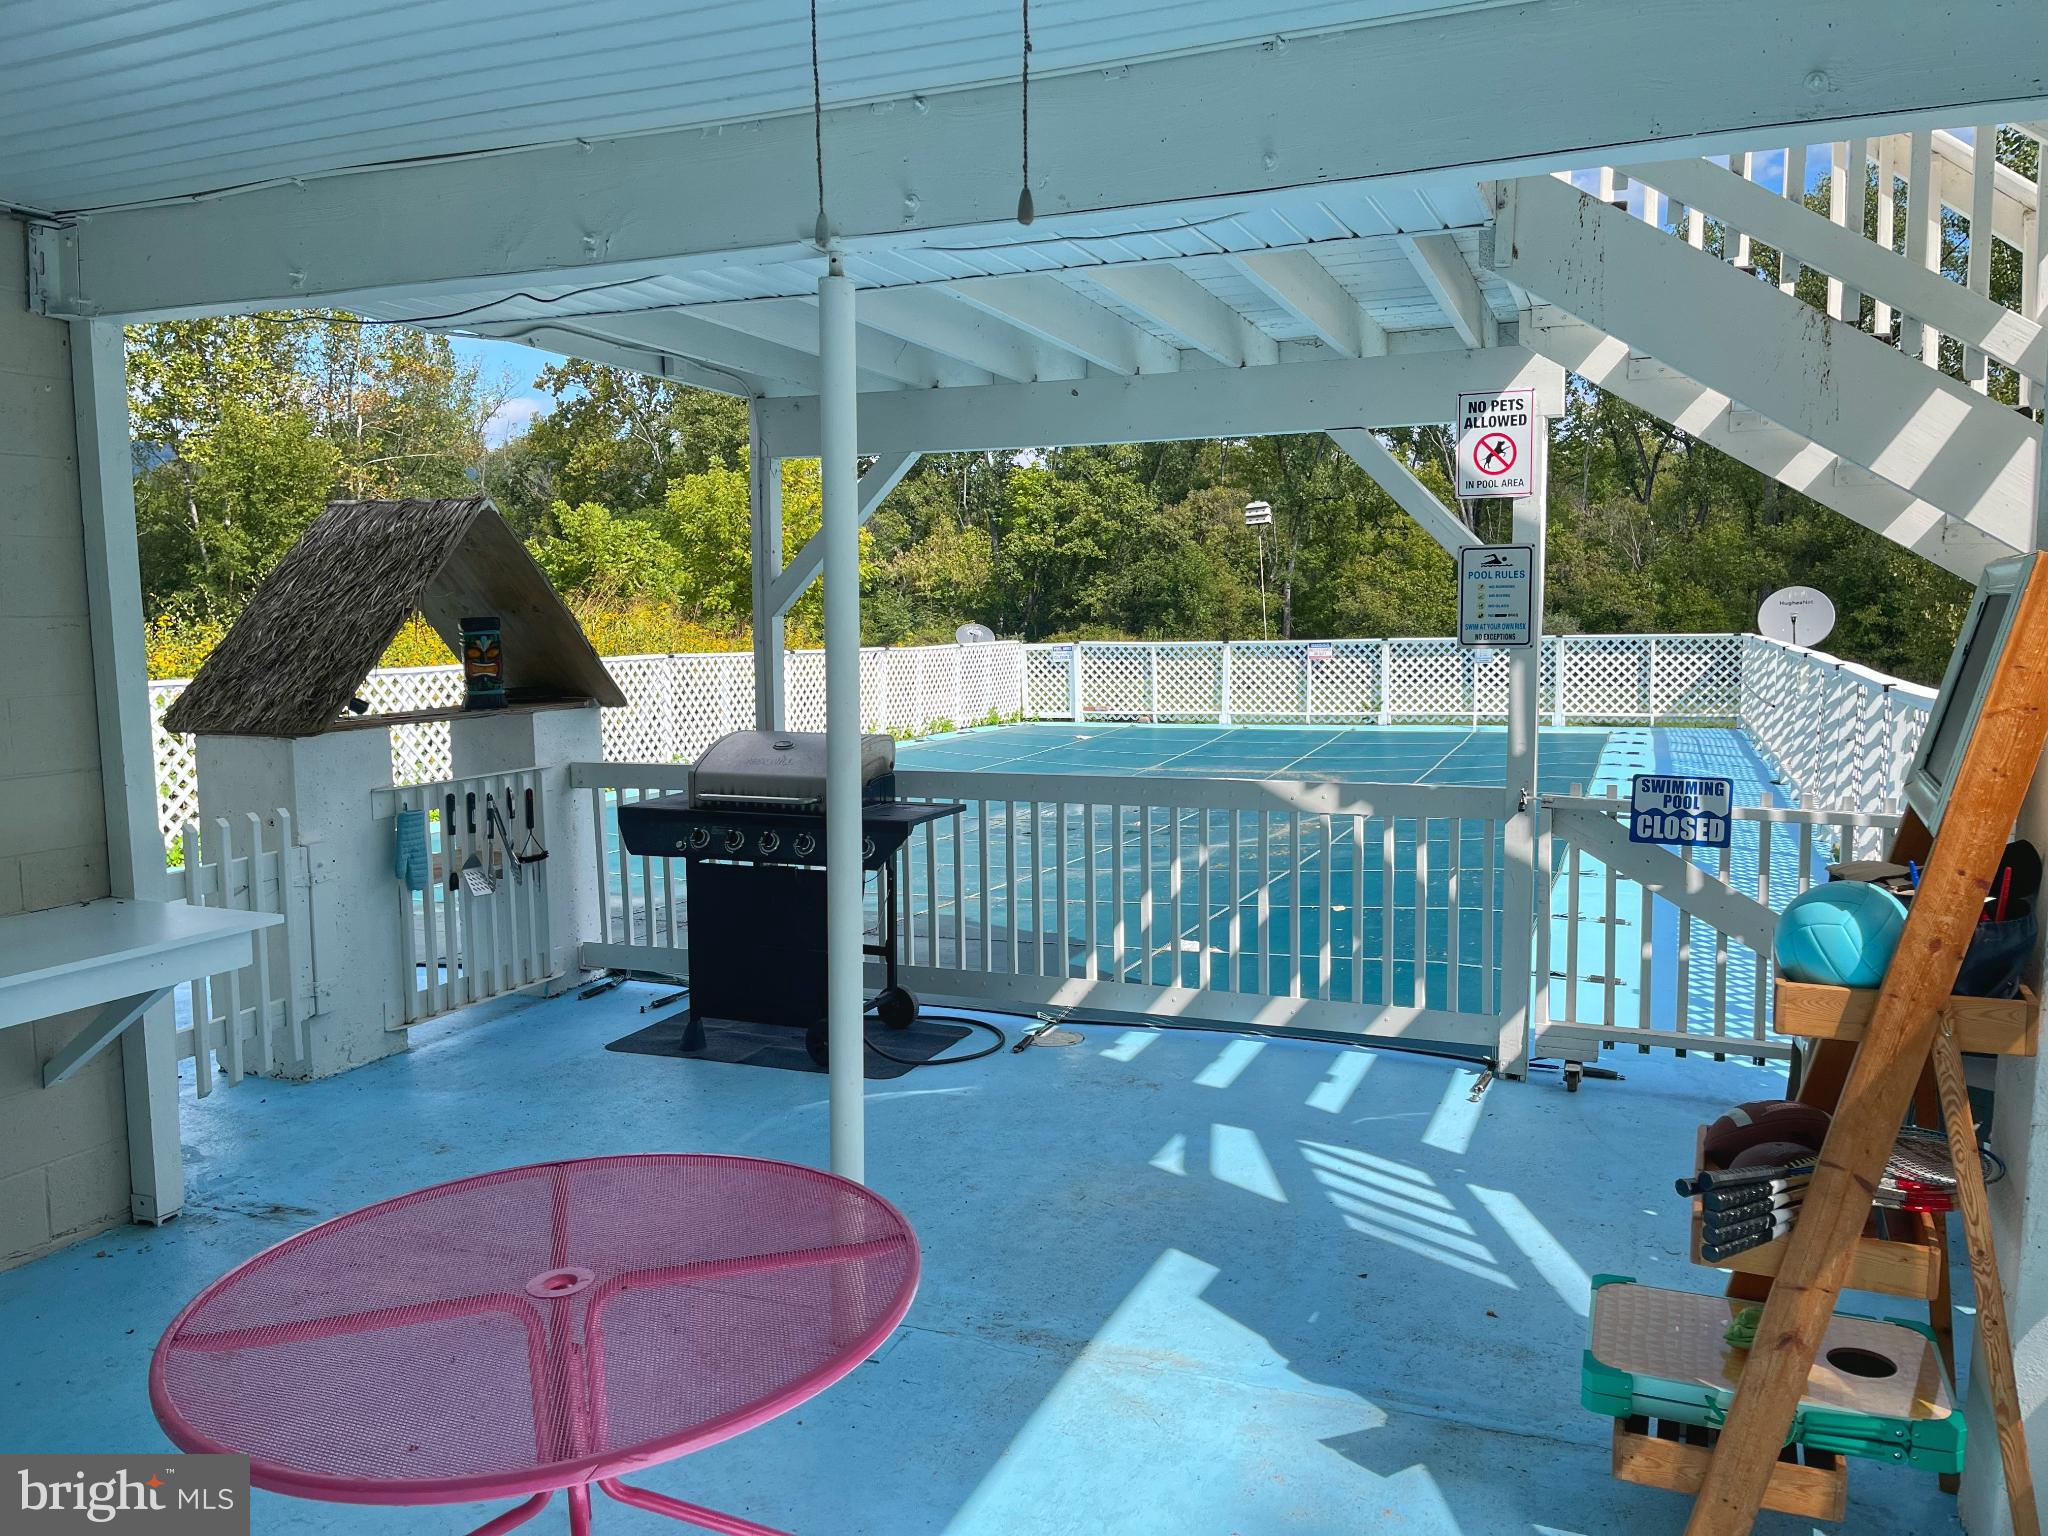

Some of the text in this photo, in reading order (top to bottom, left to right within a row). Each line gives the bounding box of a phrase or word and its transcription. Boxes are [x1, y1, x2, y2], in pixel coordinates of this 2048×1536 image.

[1468, 398, 1524, 414] NO PETS
[1464, 414, 1527, 429] ALLOWED
[1465, 478, 1525, 489] IN POOL AREA
[1468, 570, 1526, 579] POOL RULES
[1514, 622, 1526, 630] RISK
[1641, 778, 1725, 796] SWIMMING
[1663, 794, 1700, 810] POOL
[1636, 814, 1726, 842] CLOSED
